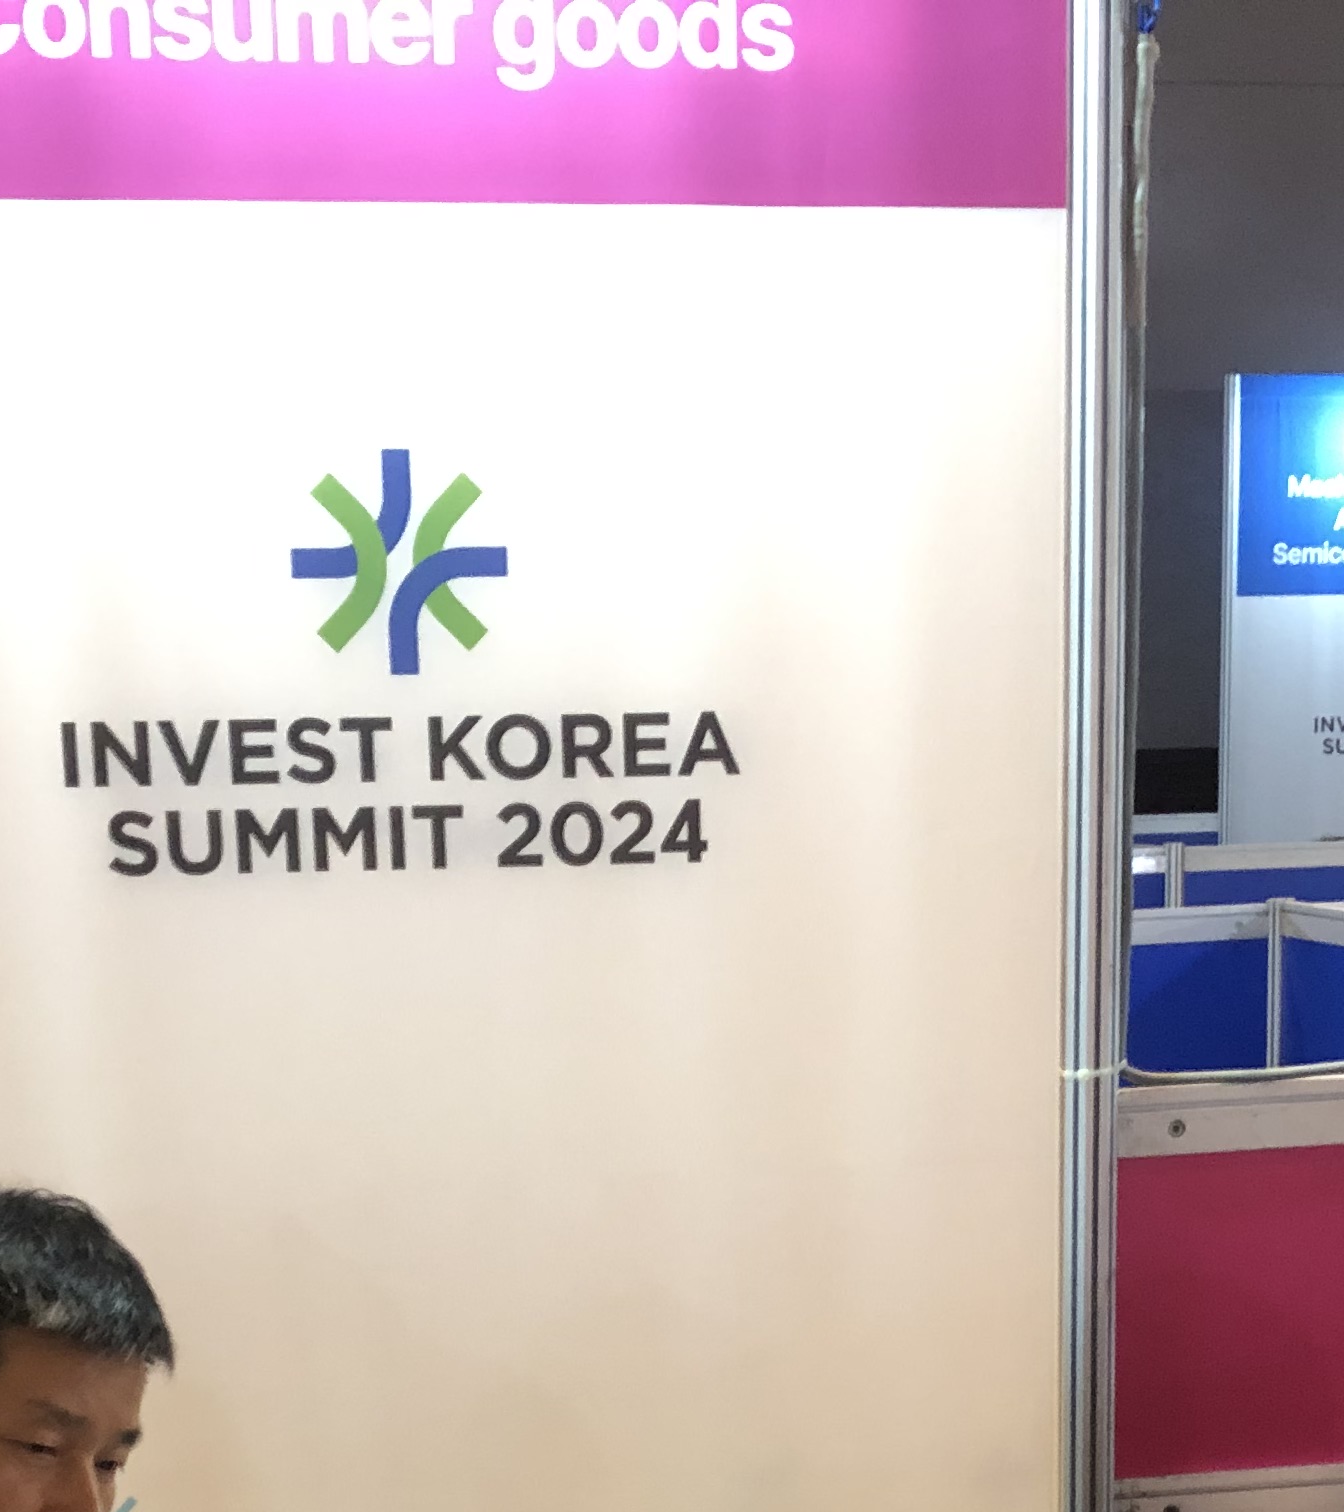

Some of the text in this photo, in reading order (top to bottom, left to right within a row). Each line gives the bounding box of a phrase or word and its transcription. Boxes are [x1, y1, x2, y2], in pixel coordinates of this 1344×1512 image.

[493, 0, 795, 91] goods
[59, 710, 741, 788] INVEST KOREA
[108, 798, 709, 878] SUMMIT 2024
